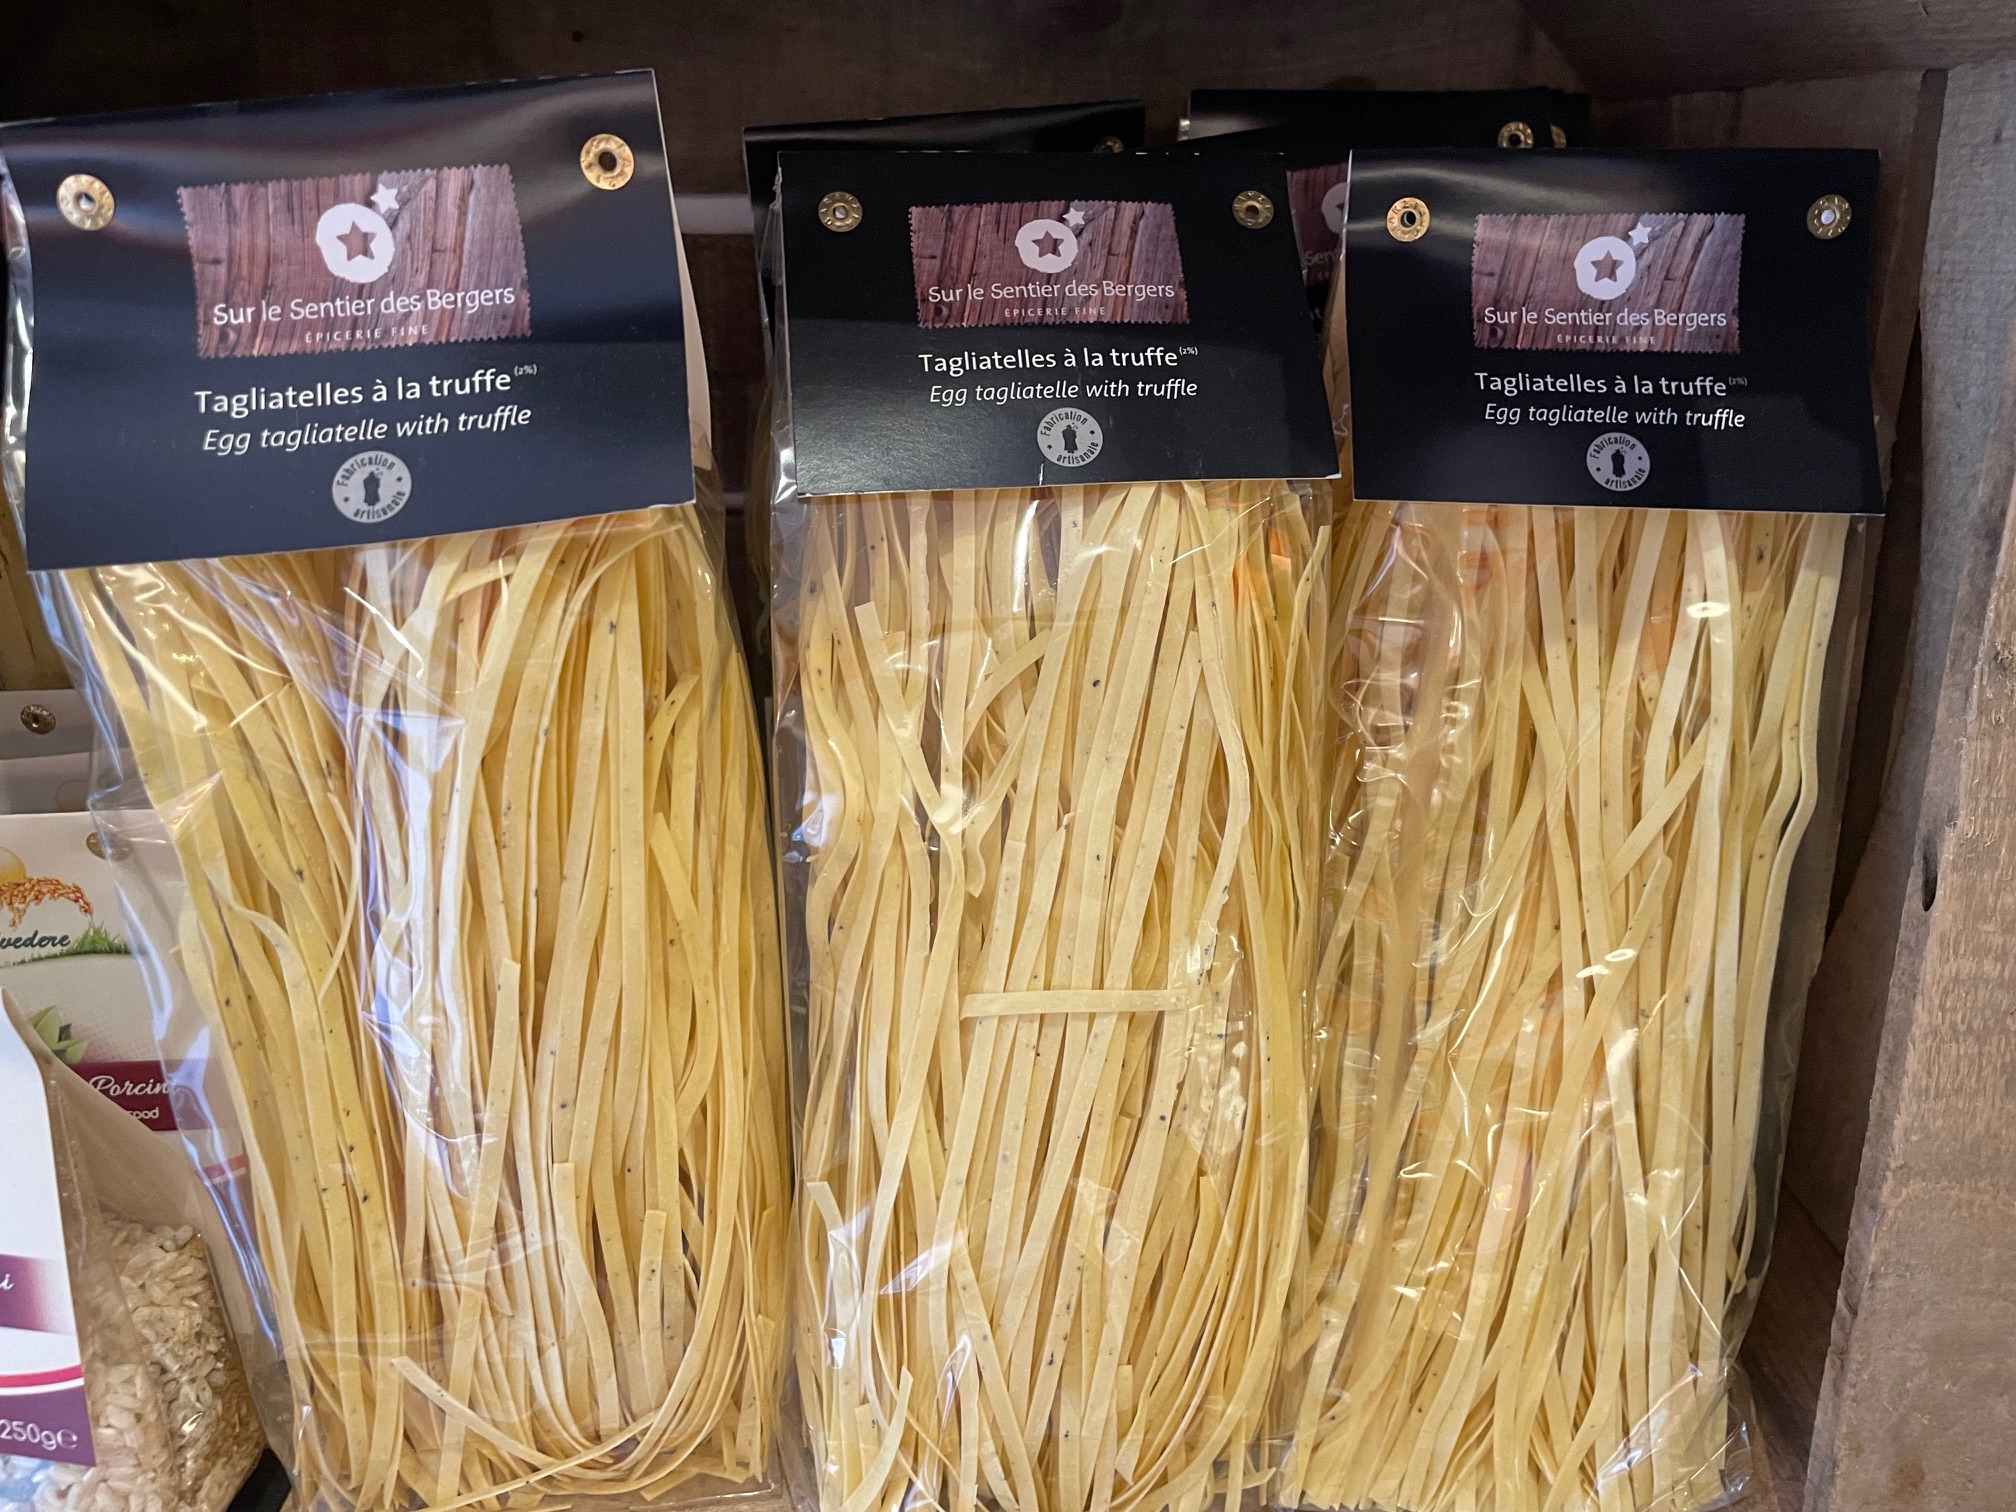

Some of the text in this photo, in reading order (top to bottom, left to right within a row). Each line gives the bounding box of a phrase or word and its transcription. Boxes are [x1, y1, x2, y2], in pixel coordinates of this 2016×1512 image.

[928, 280, 1175, 302] Sur le Sentier des Bergers
[213, 286, 516, 326] Sur le Sentier des Bergers
[1004, 306, 1106, 318] ÉPICERIE FINE
[1484, 307, 1727, 331] Sur le Sentier des Bergers
[305, 324, 429, 344] ÉPICERIE FINE
[1557, 333, 1656, 345] ÉPICERIE FINE
[918, 349, 1057, 377] Tagliatelles
[1063, 348, 1077, 367] à
[1083, 348, 1104, 367] la
[1109, 347, 1178, 367] truffe
[195, 381, 363, 419] Tagliatelles
[371, 379, 388, 402] à
[397, 376, 422, 400] la
[428, 368, 512, 397] truffe
[929, 378, 1198, 407] Egg tagliatelle with truffle
[1474, 372, 1607, 397] Tagliatelles
[1614, 375, 1627, 394] à
[1634, 375, 1653, 395] la
[1659, 376, 1727, 396] truffe
[203, 404, 532, 456] Egg tagliatelle with truffle
[1485, 403, 1746, 431] Egg tagliatelle with truffle
[1040, 410, 1099, 465] Fabrication artisanale
